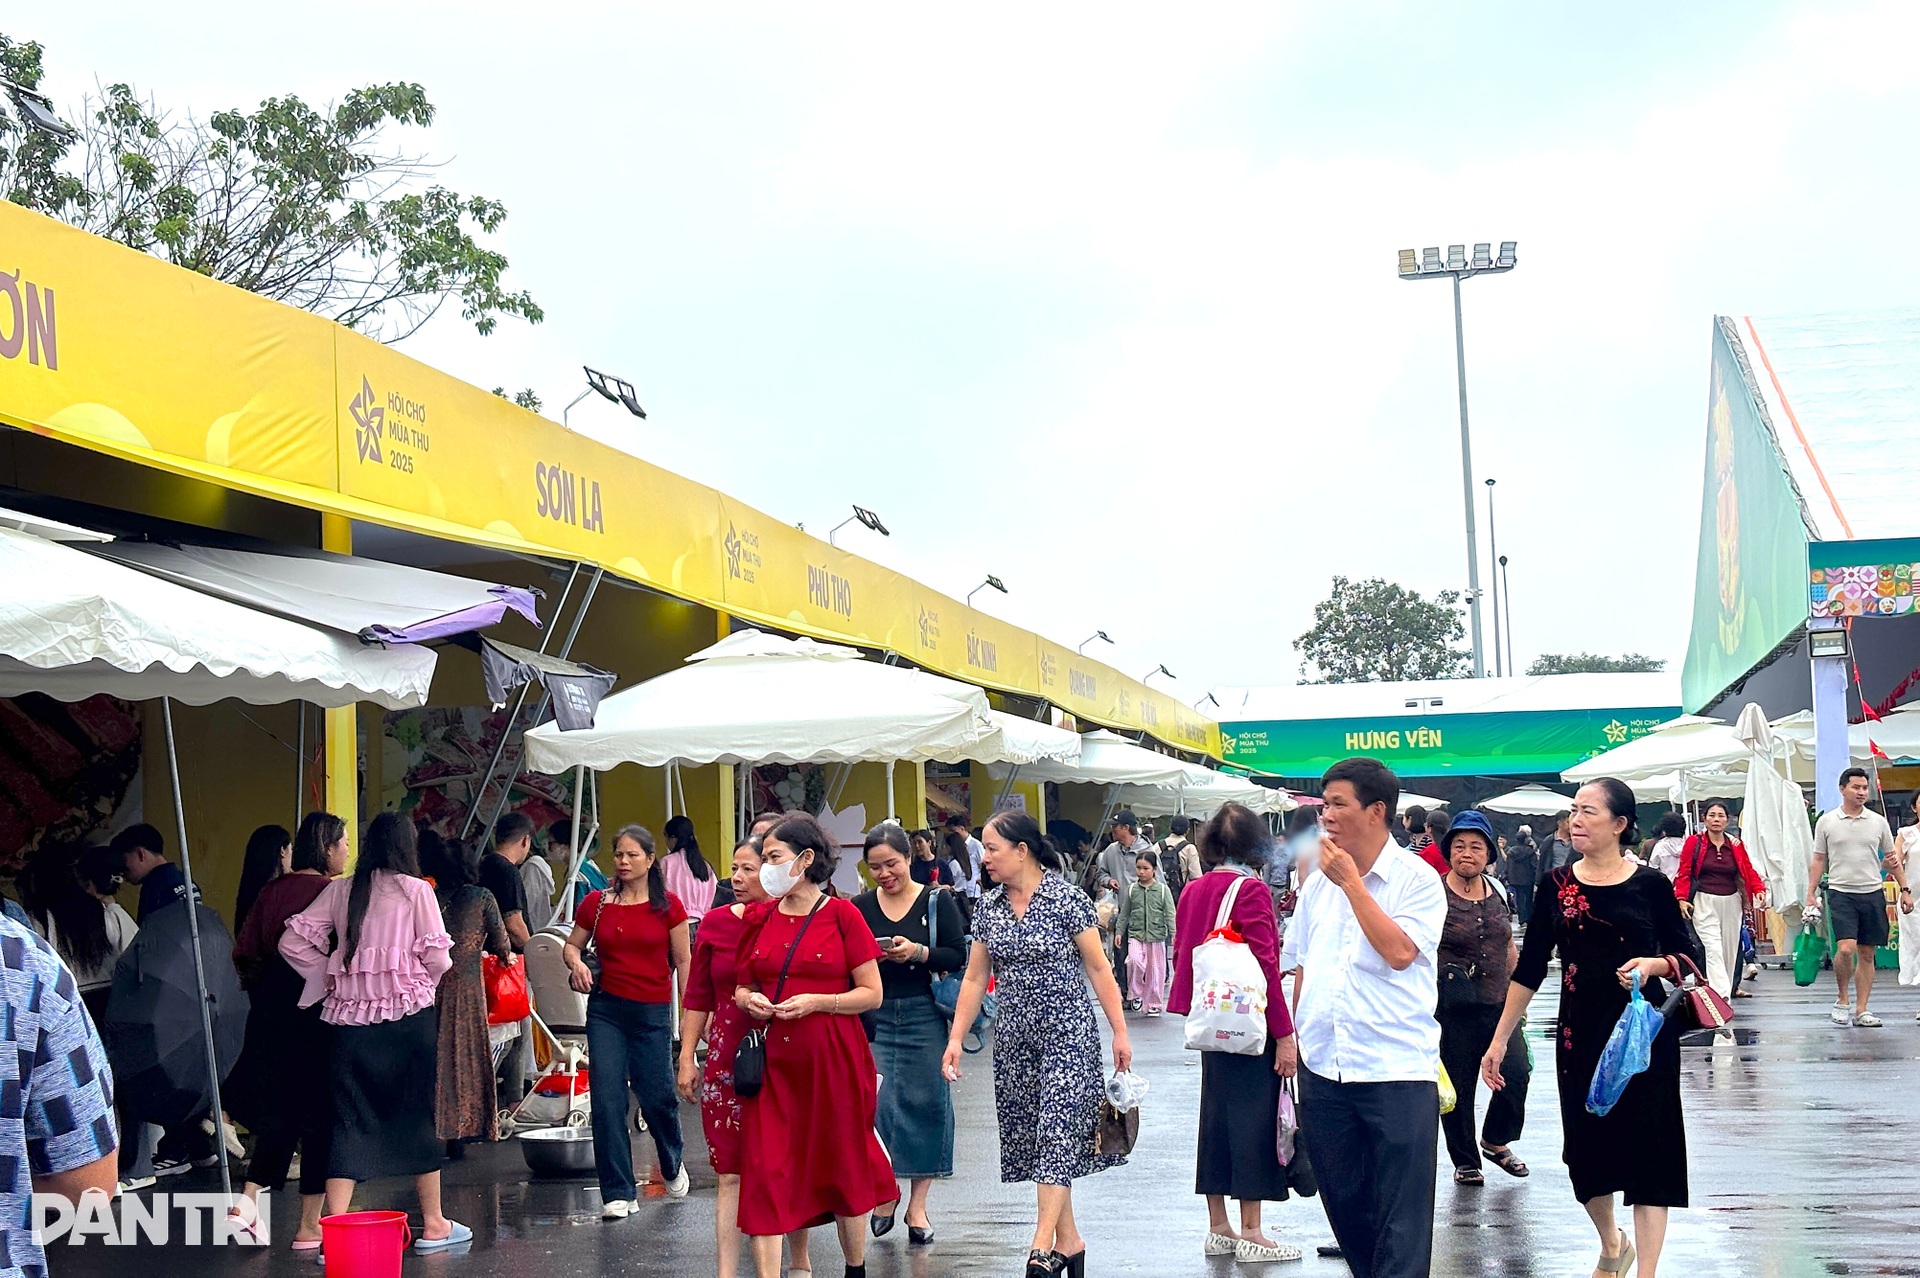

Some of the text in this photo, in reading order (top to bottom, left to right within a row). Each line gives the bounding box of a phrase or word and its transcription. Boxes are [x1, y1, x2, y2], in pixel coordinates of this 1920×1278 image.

[388, 391, 426, 427] HỘI CHỢ
[389, 420, 430, 452] MÙA THU
[390, 449, 414, 475] 2025
[535, 461, 604, 534] SƠN LA
[807, 564, 852, 622] PHÚ THỌ
[1238, 731, 1251, 741] HỘI
[1345, 726, 1442, 750] HƯNG YÊN
[1216, 1029, 1246, 1037] FRONTLINE
